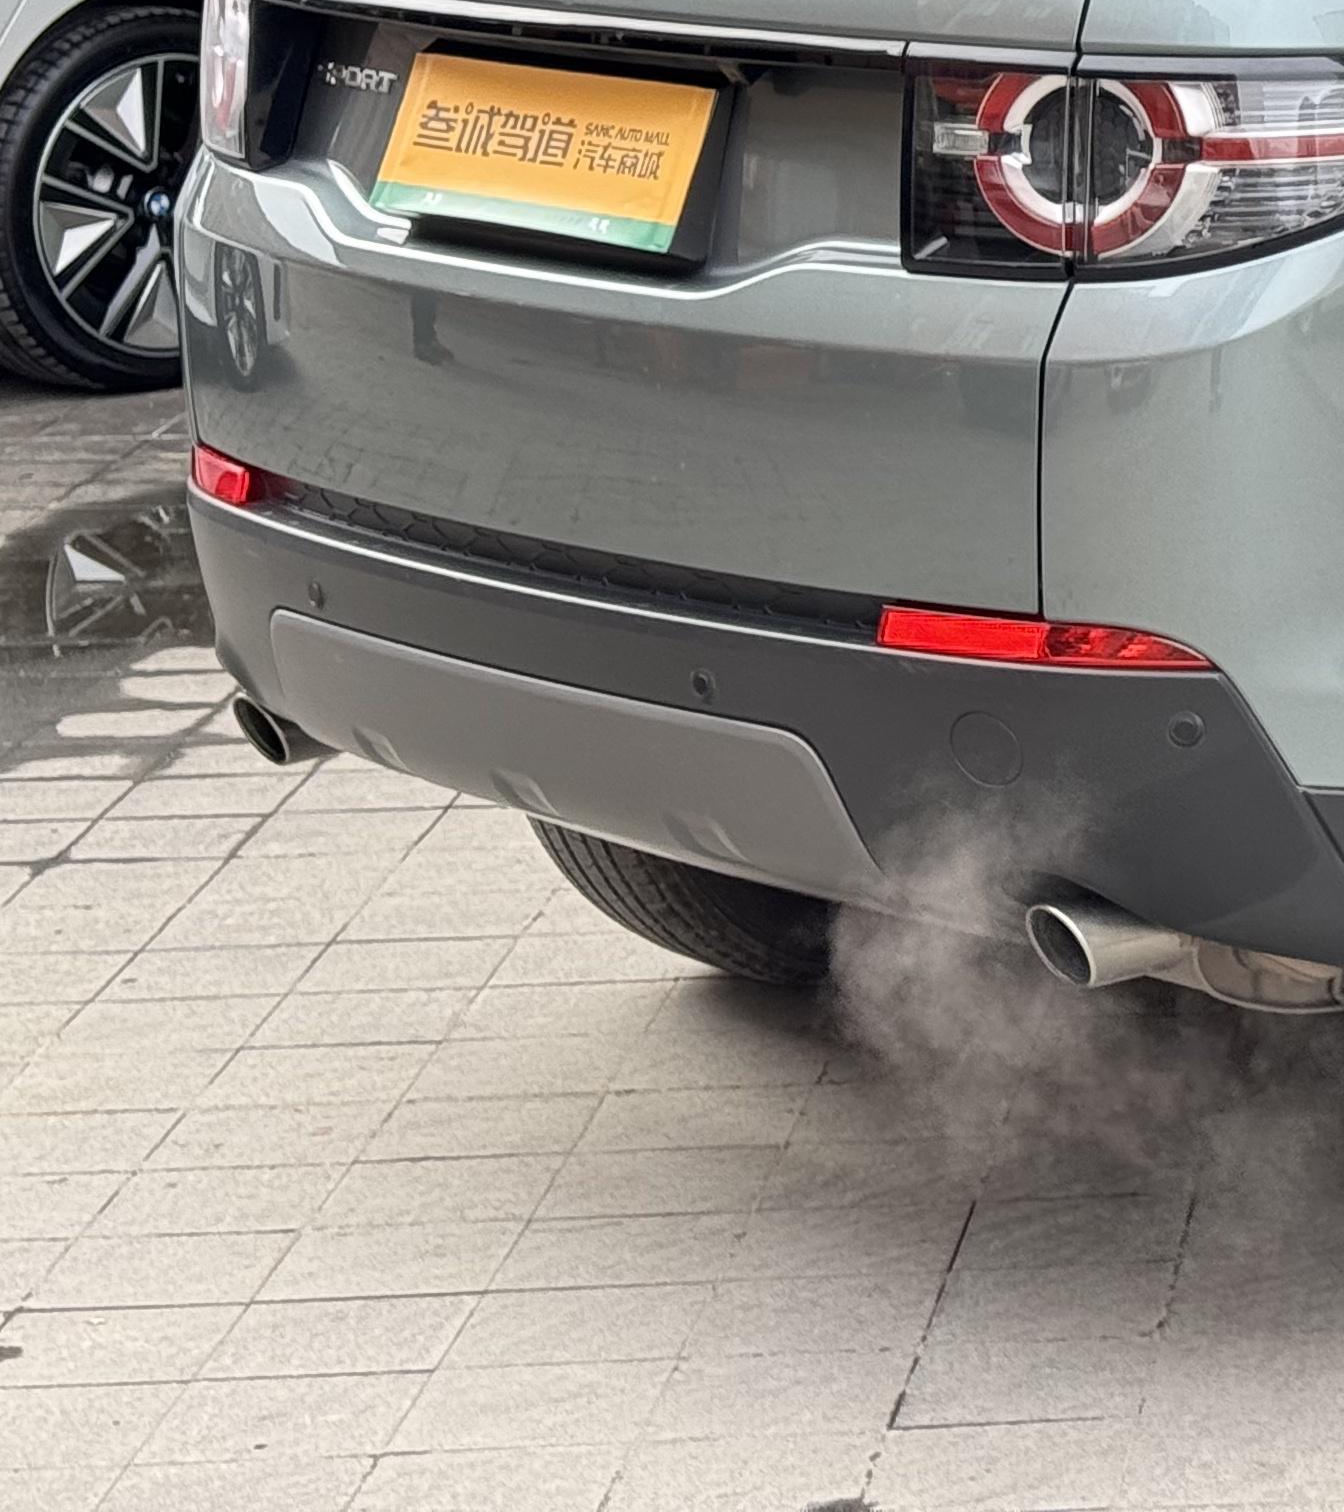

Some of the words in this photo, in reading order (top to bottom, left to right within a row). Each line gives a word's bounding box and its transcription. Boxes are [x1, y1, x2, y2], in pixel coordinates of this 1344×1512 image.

[413, 99, 578, 167] 叁诚驾道
[615, 126, 643, 143] AUTO
[642, 130, 670, 147] MALL
[573, 140, 665, 180] 汽车商城
